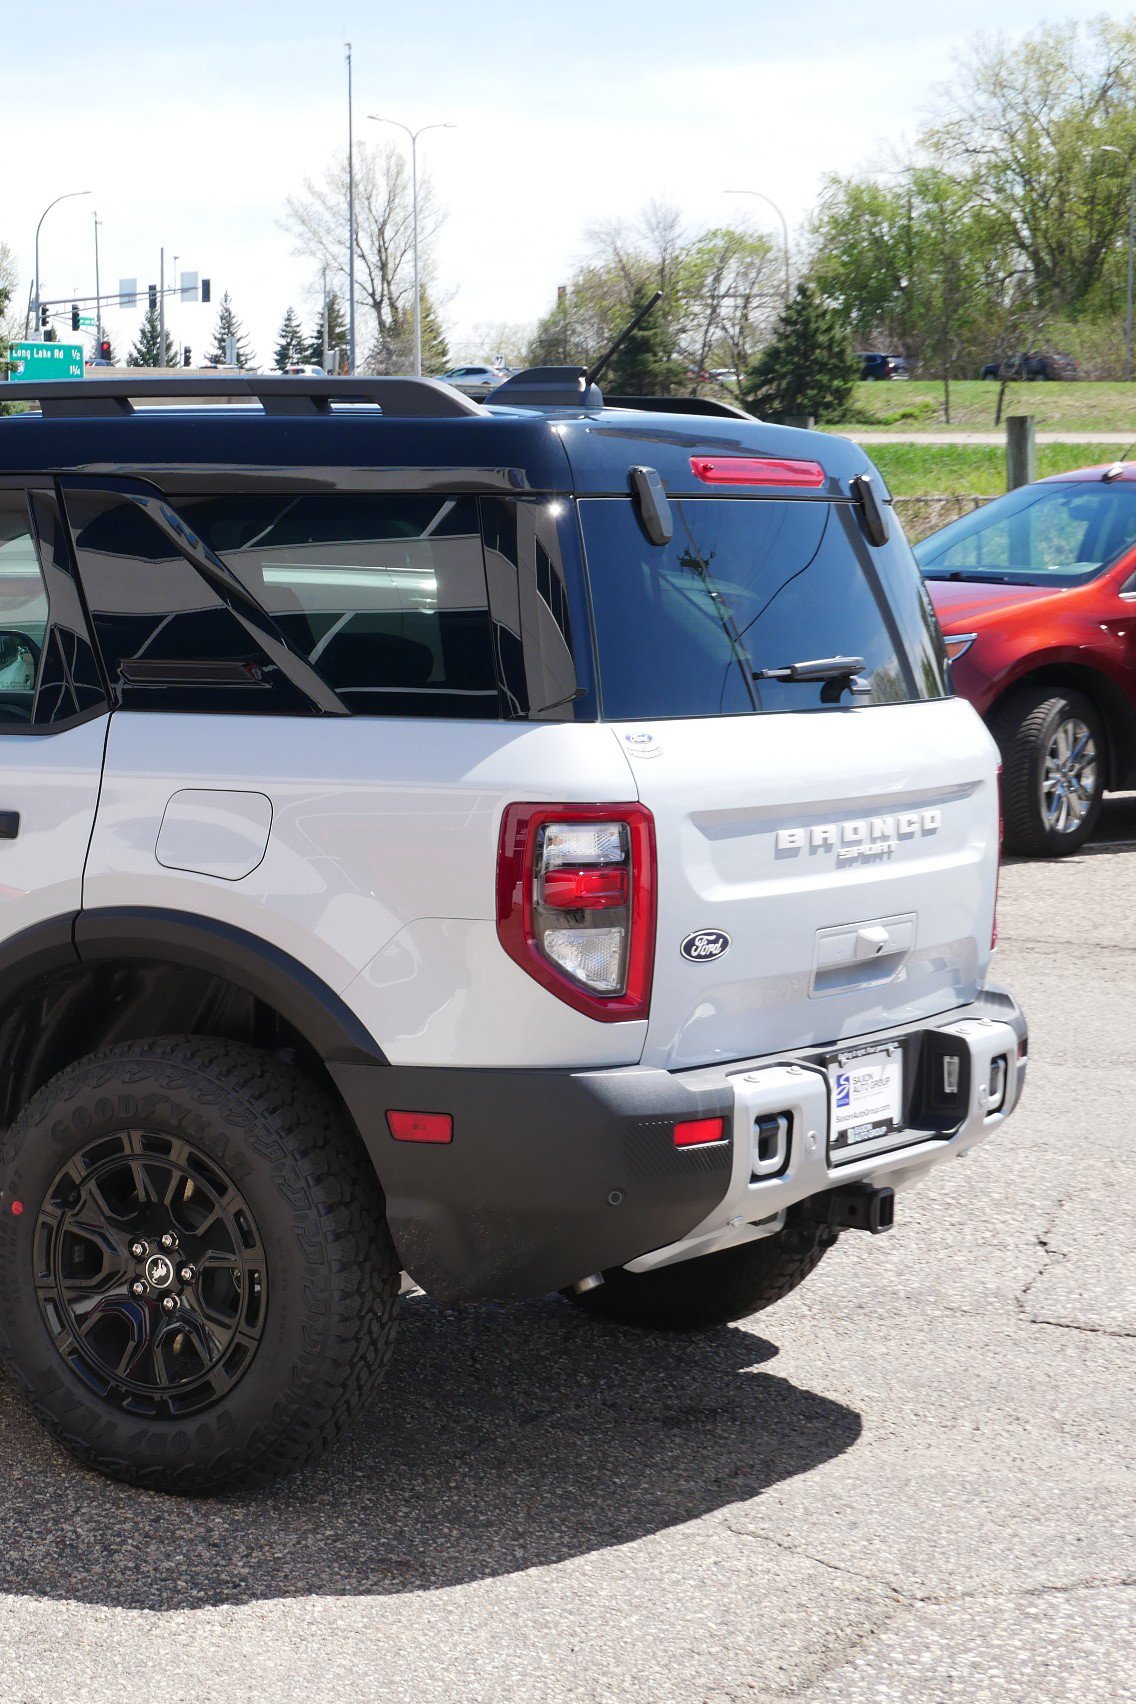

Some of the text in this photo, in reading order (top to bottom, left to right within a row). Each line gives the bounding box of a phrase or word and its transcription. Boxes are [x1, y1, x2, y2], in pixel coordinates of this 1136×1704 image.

[12, 349, 30, 360] Long
[34, 348, 51, 358] Lake
[54, 348, 64, 359] Rd
[776, 810, 942, 851] BRONCO
[837, 842, 897, 860] SPORT
[691, 935, 724, 957] Ford
[51, 1092, 252, 1184] GOODYEAR
